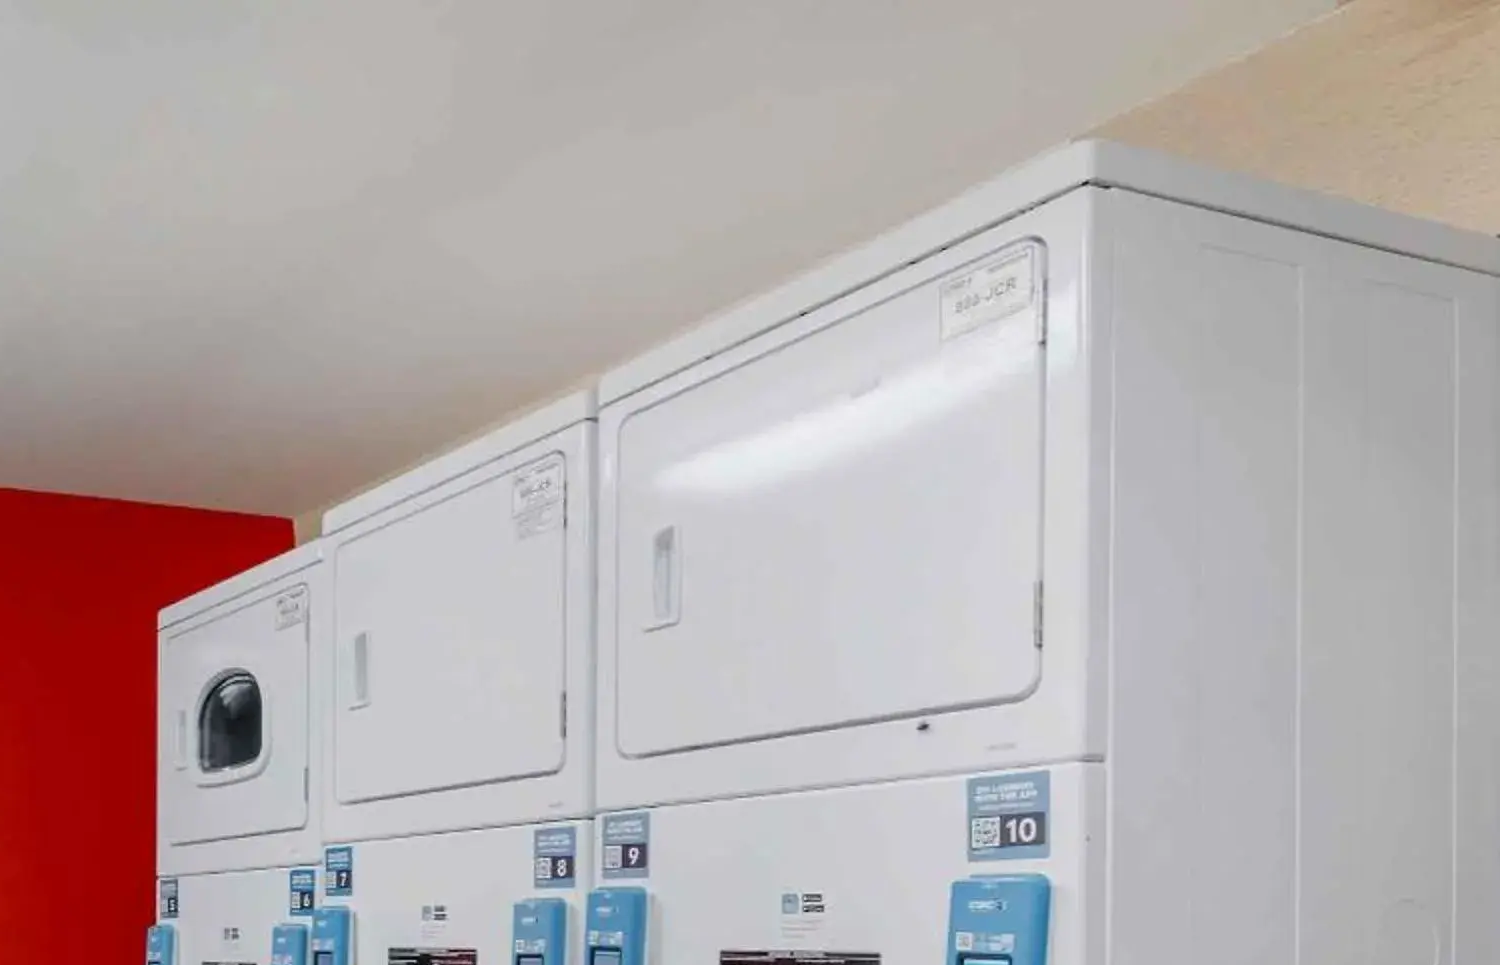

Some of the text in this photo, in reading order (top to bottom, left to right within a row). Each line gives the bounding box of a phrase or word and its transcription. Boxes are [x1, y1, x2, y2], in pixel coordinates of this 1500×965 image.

[1005, 817, 1037, 843] 10
[629, 847, 639, 865] 9
[557, 859, 567, 877] 8
[340, 871, 347, 887] 7
[303, 893, 310, 907] 6
